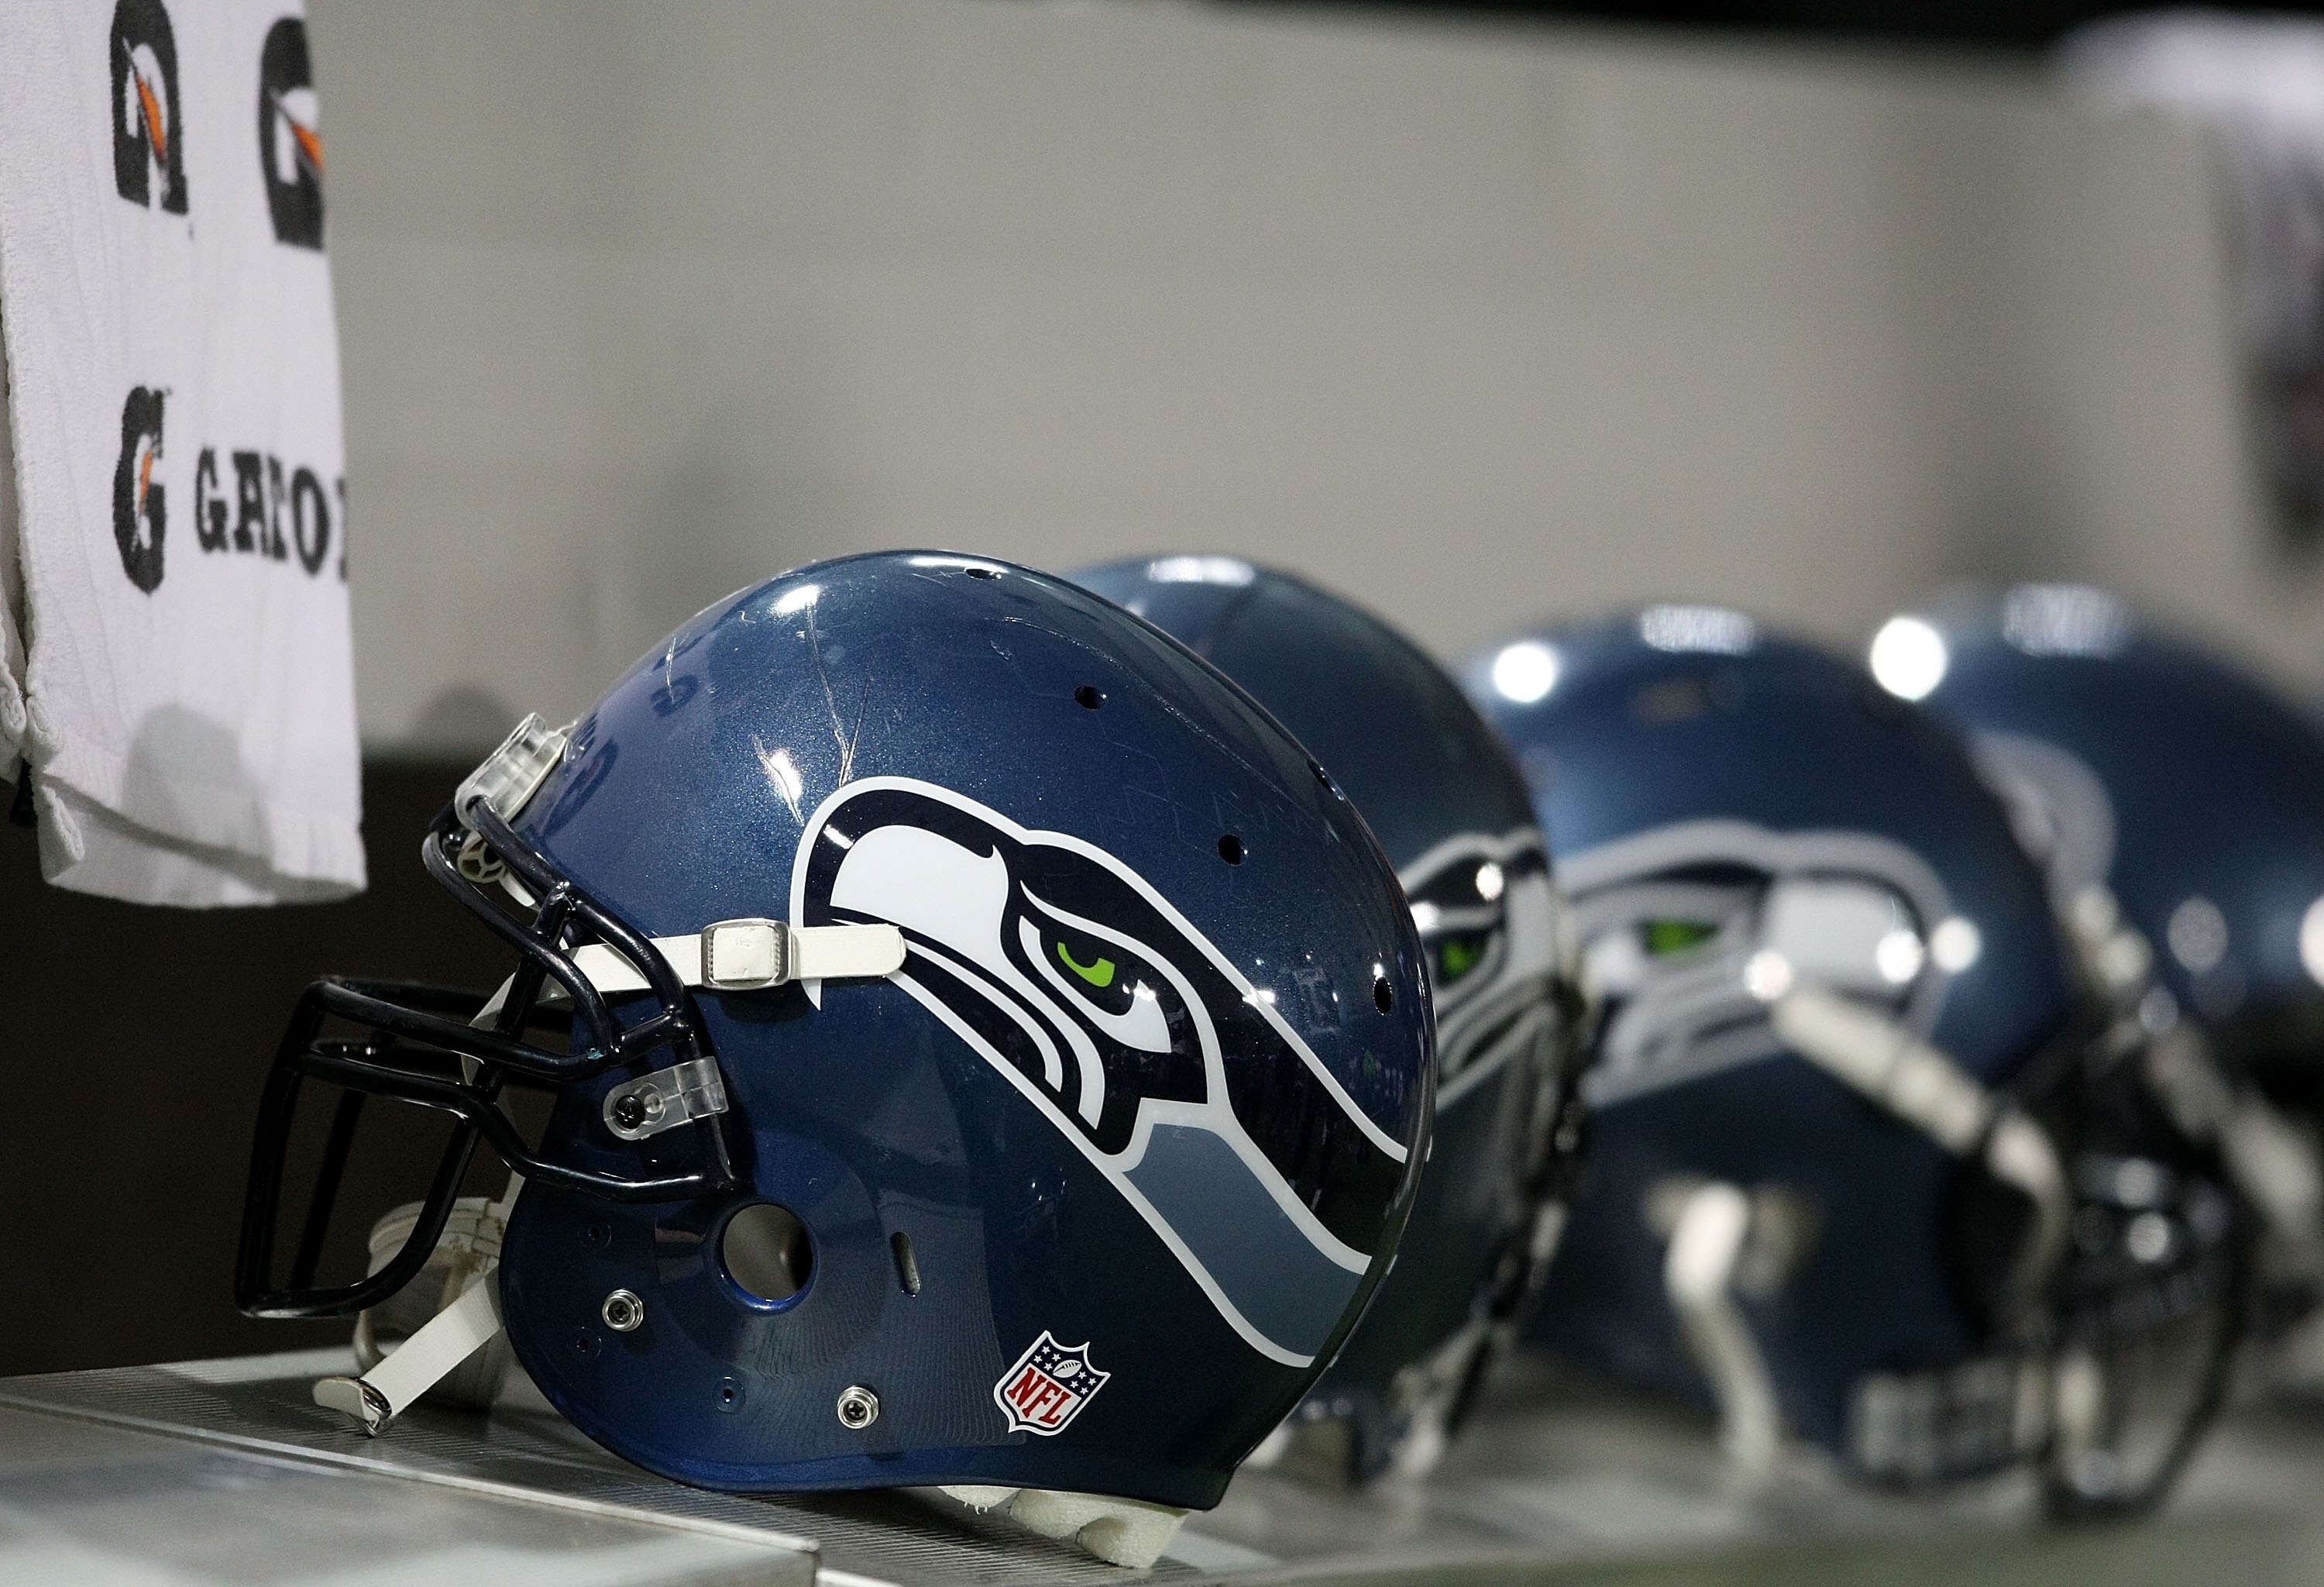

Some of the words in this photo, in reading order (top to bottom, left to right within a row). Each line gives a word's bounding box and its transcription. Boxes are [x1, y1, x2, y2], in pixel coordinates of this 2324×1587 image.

[112, 386, 166, 596] G
[195, 446, 346, 584] GAO
[1006, 1366, 1071, 1425] NFL
